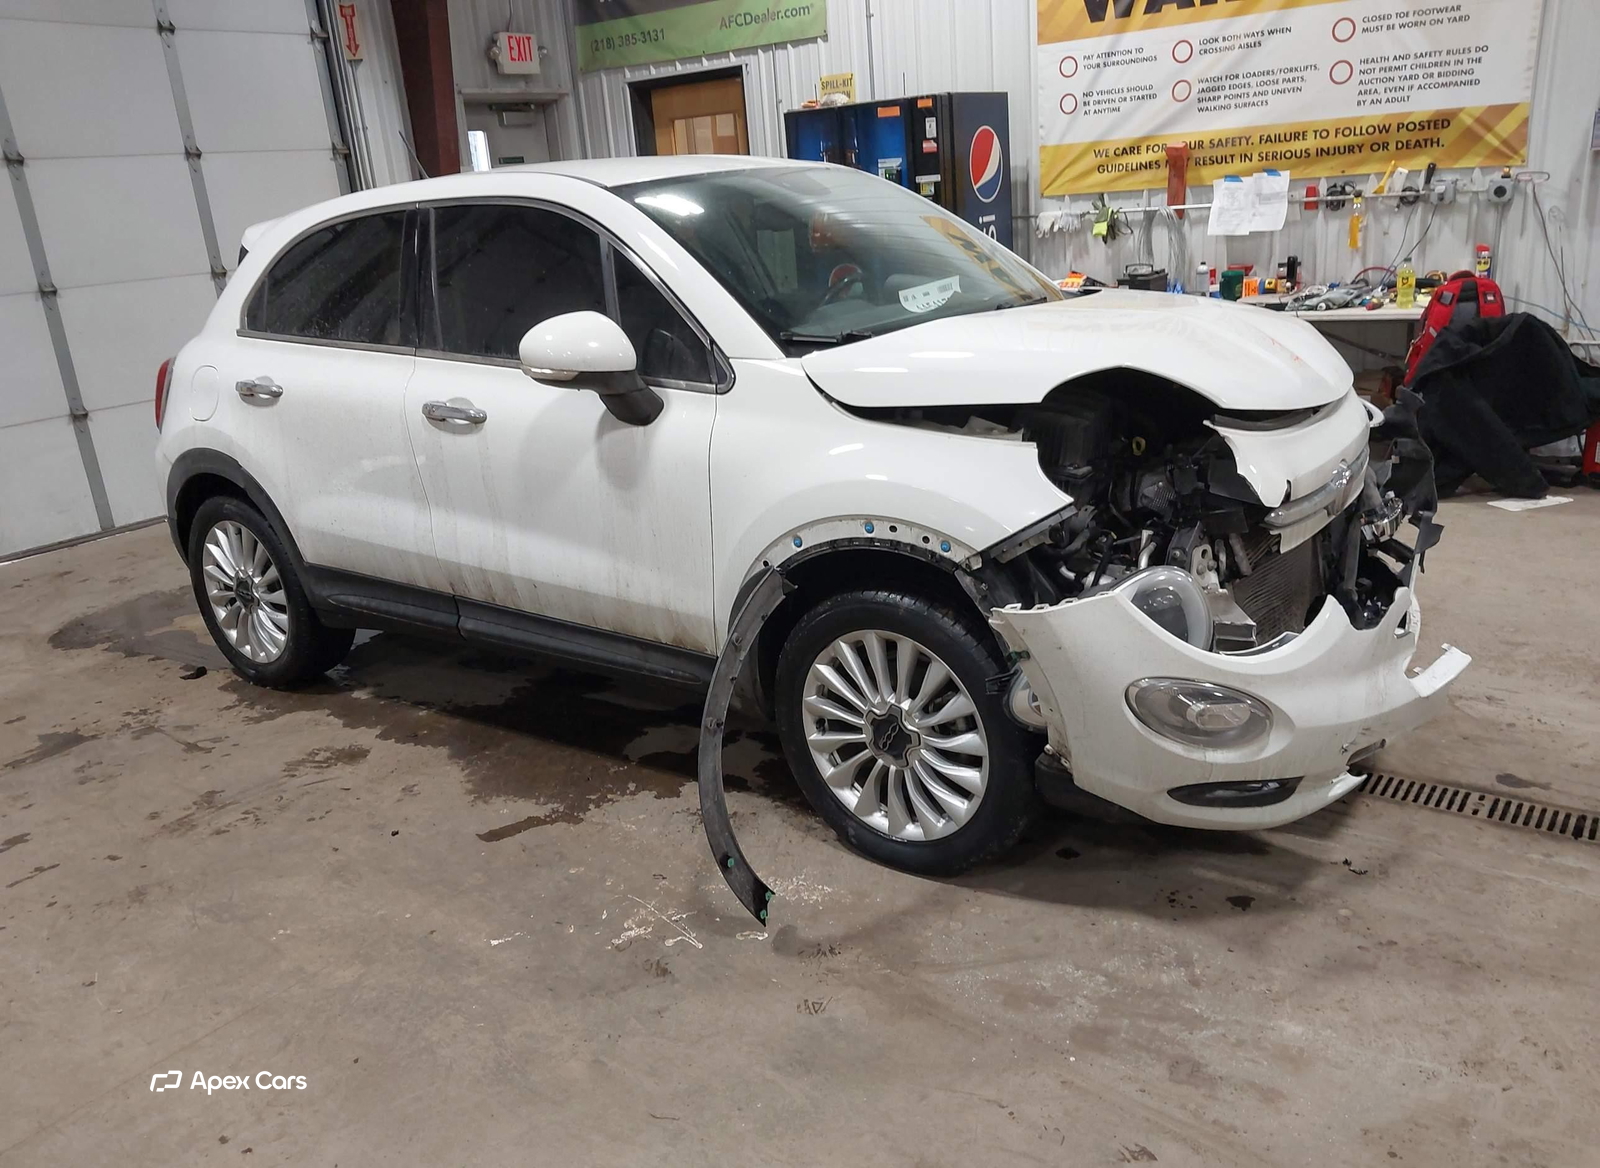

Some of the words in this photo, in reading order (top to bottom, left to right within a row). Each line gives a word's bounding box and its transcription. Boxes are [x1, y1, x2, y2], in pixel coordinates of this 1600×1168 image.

[1362, 13, 1392, 23] CLOSED
[1395, 11, 1409, 19] TOE
[1413, 5, 1462, 17] FOOTWEAR
[1362, 25, 1383, 34] MUST
[1399, 19, 1426, 29] WORN
[1429, 18, 1443, 26] ON
[1447, 15, 1470, 23] YARD
[591, 37, 615, 54] (218)
[618, 28, 665, 47] 385-3131
[1199, 37, 1219, 45] LOOK
[1222, 34, 1241, 42] BOTH
[1243, 30, 1265, 39] WAYS
[1267, 27, 1292, 36] WHEN
[507, 35, 533, 62] EXIT
[1096, 49, 1132, 59] ATTENTION
[1199, 45, 1235, 55] CROSSING
[1238, 41, 1262, 50] AISLES
[1360, 56, 1389, 65] HEALTH
[1392, 54, 1411, 62] AND
[1414, 50, 1443, 60] SAFETY
[1446, 47, 1471, 56] RULES
[1475, 45, 1488, 53] DO
[1103, 55, 1157, 68] SURROUNDINGS
[1379, 64, 1407, 74] PERMIT
[1410, 59, 1451, 70] CHILDREN
[1454, 58, 1463, 66] IN
[1467, 56, 1482, 64] THE
[821, 78, 852, 90] SPILL-KIT
[1198, 74, 1222, 84] WATCH
[1358, 76, 1395, 86] AUCTION
[1398, 73, 1419, 82] YARD
[1422, 72, 1434, 80] OR
[1438, 68, 1474, 78] BIDDING
[1096, 87, 1124, 96] VEHICLES
[1126, 84, 1153, 93] SHOULD
[1197, 85, 1226, 94] JAGGED
[1256, 78, 1279, 87] LOOSE
[1384, 85, 1405, 94] EVEN
[1417, 79, 1480, 91] ACCOMPANIED
[1130, 93, 1157, 102] STARTED
[1197, 95, 1221, 104] SHARP
[1223, 92, 1250, 100] POINTS
[1253, 90, 1269, 98] AND
[1271, 86, 1302, 95] UNEVEN
[1385, 95, 1411, 104] ADULT
[1093, 106, 1121, 115] ANYTIME
[1197, 103, 1232, 113] WALKING
[1234, 99, 1269, 109] SURFACES
[1093, 147, 1110, 158] WE
[1113, 145, 1142, 157] CARE
[1209, 135, 1254, 149] SAFETY.
[1259, 131, 1308, 144] FAILURE
[1312, 129, 1330, 140] TO
[1334, 123, 1391, 139] FOLLOW
[1396, 118, 1451, 133] POSTED
[1097, 160, 1161, 174] GUIDELINES
[1194, 154, 1235, 167] RESULT
[1239, 152, 1253, 163] IN
[1257, 148, 1311, 162] SERIOUS
[1315, 143, 1365, 157] INJURY
[1369, 142, 1390, 152] OR
[1395, 137, 1445, 151] DEATH.
